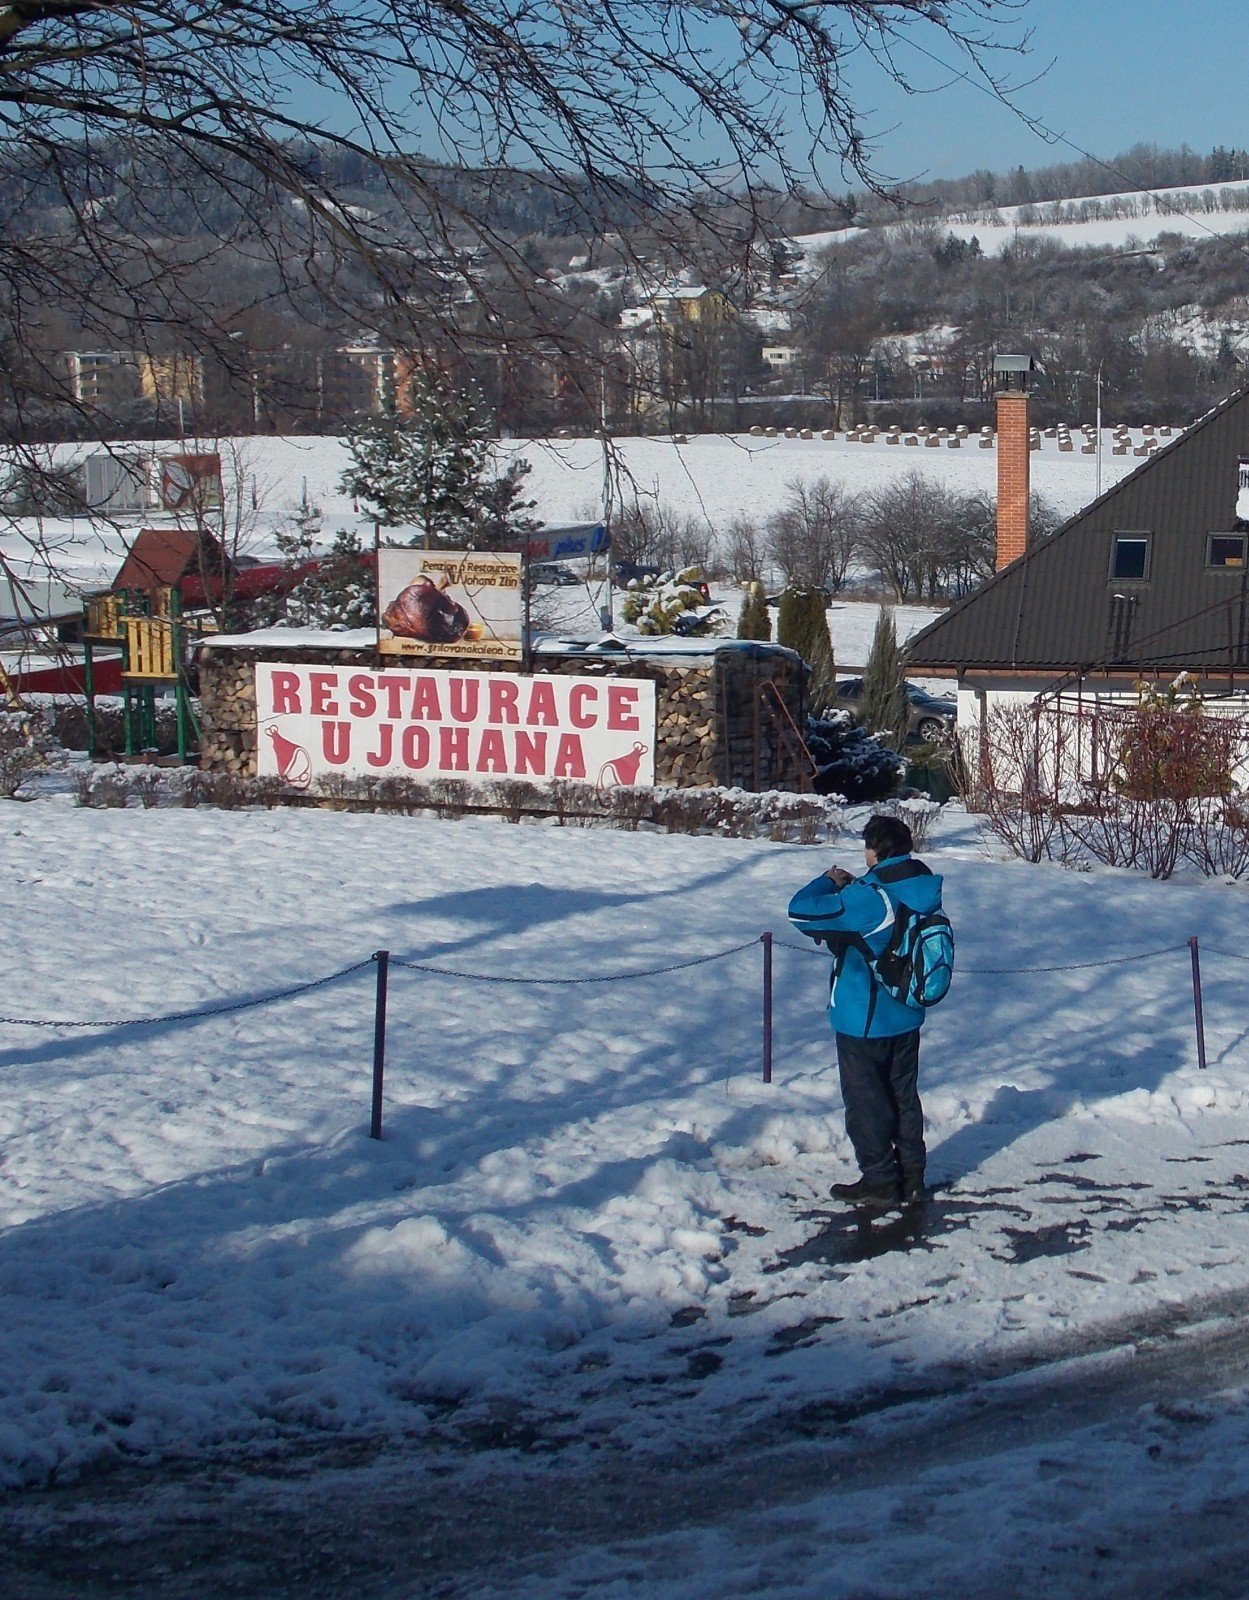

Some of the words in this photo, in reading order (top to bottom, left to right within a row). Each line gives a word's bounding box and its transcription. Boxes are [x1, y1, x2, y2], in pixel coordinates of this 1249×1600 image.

[422, 560, 458, 571] Penzion
[467, 563, 518, 574] Restaurace
[452, 574, 461, 585] U
[499, 576, 518, 587] Zlín
[401, 643, 518, 656] www.grilovanakolena.cz
[270, 670, 640, 732] RESTAURACE
[321, 720, 351, 765] U
[366, 723, 587, 779] JOHANA
